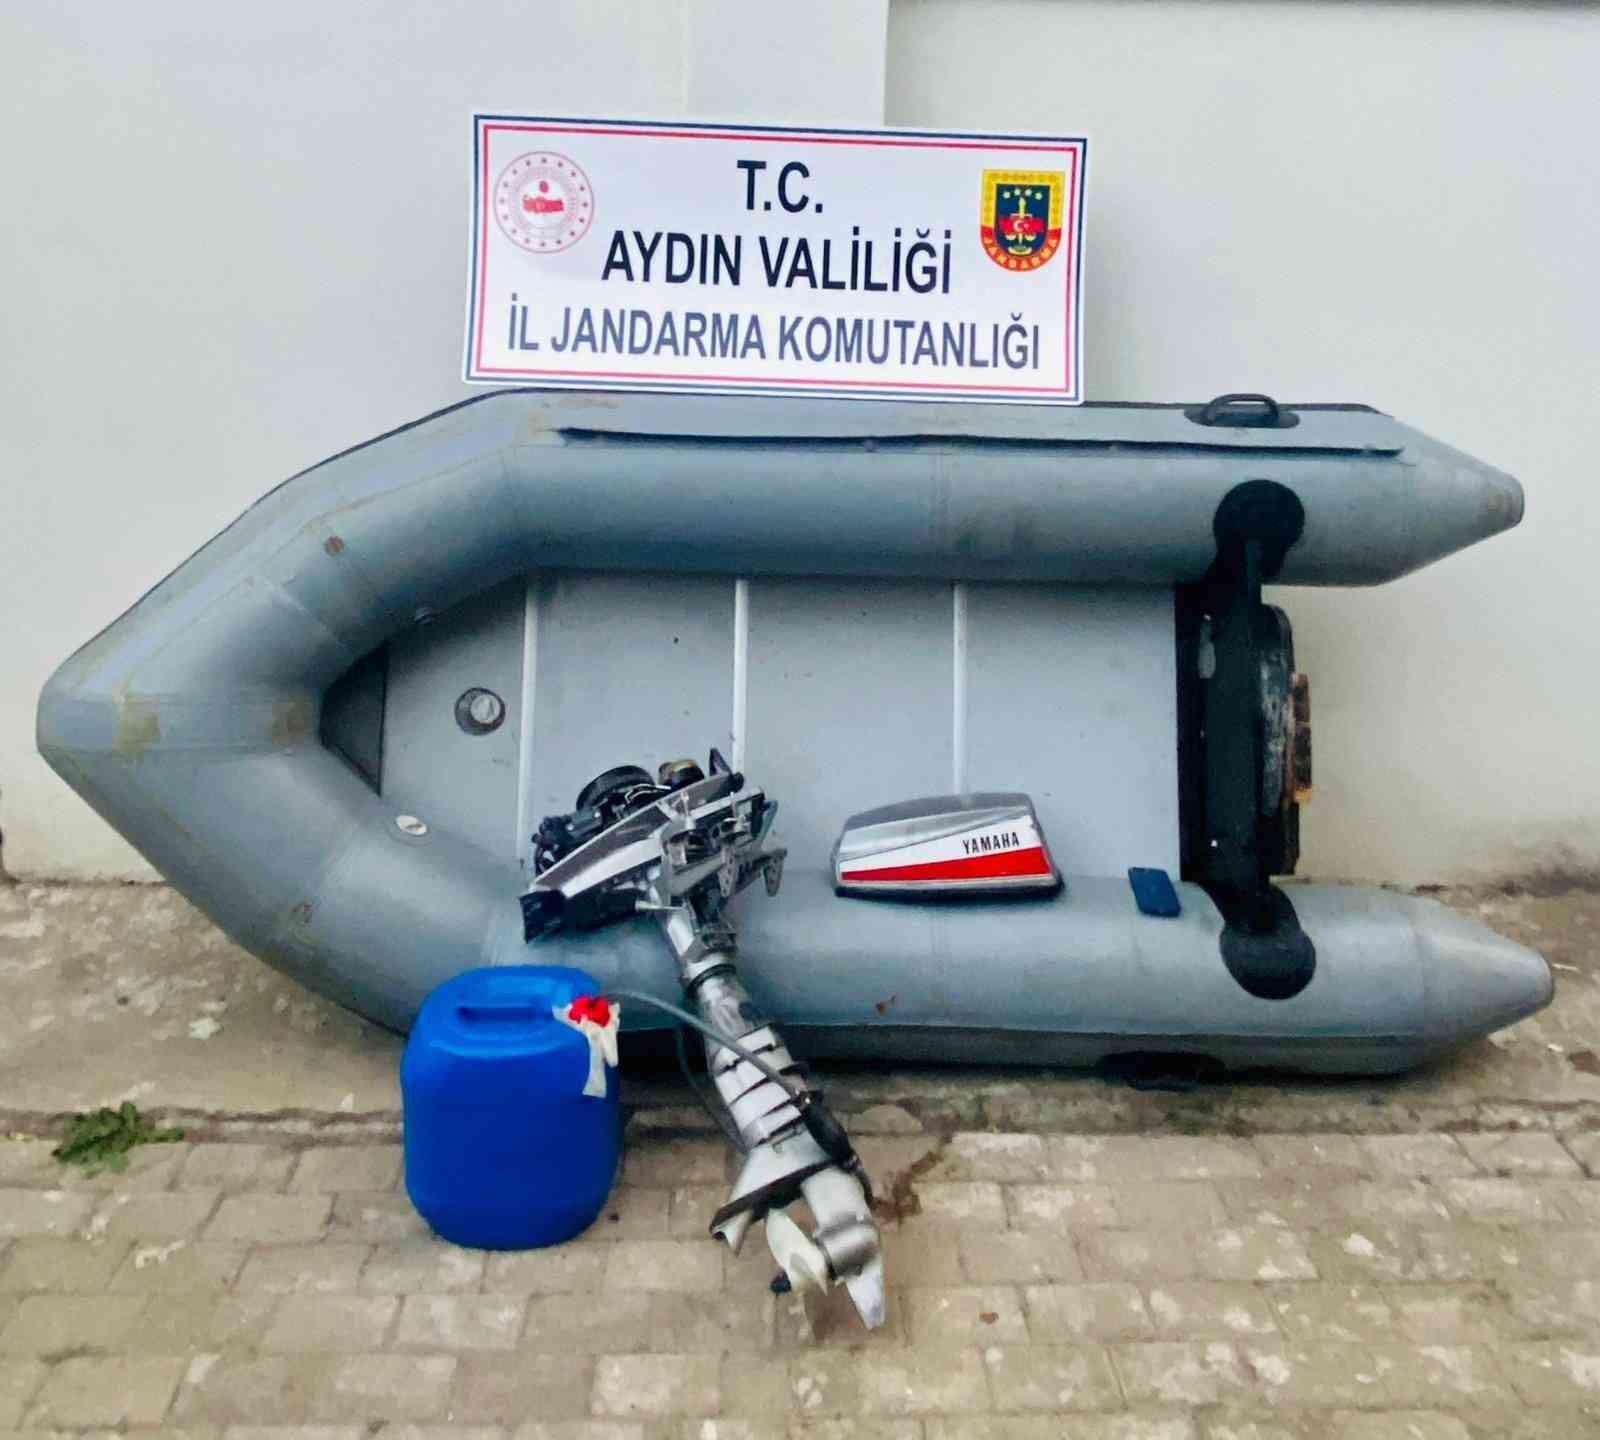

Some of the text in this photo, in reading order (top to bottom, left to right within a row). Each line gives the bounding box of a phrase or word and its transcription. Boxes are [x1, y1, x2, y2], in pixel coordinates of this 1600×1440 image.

[736, 159, 823, 214] T.C.
[602, 226, 951, 294] AYDIN VALİLİĞİ
[508, 293, 1039, 370] İL JANDARMA KOMUTANLIĞI
[962, 831, 1020, 855] YAMAHA
